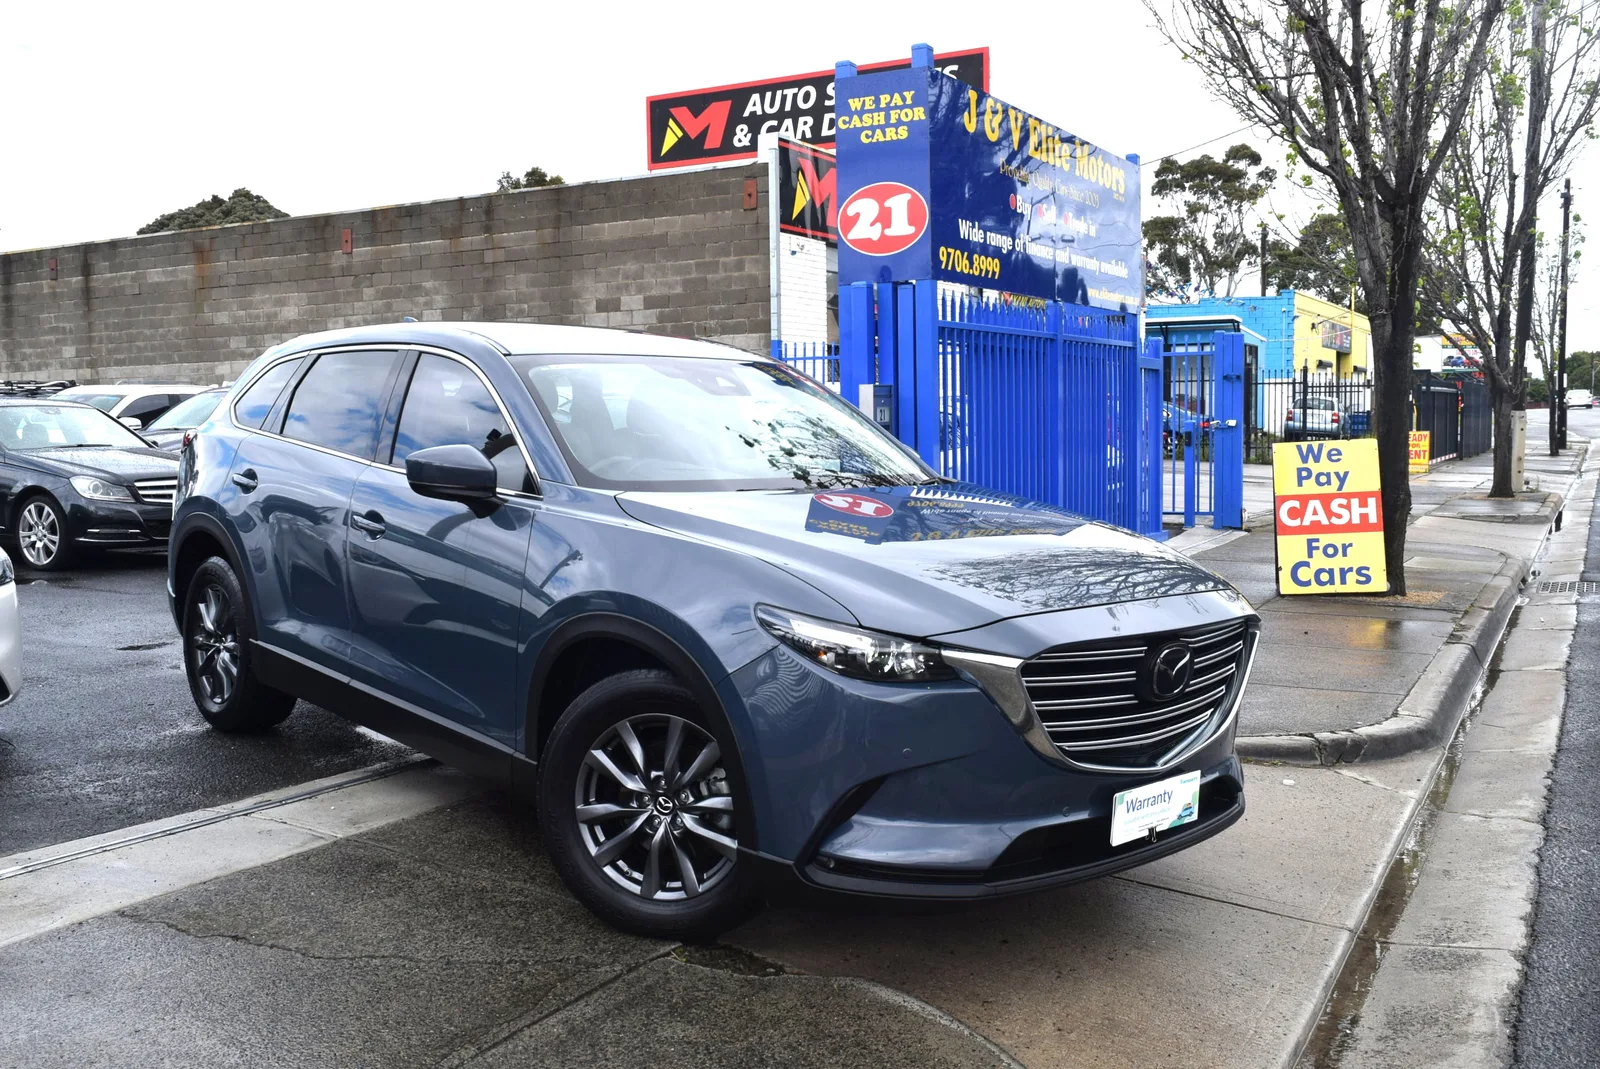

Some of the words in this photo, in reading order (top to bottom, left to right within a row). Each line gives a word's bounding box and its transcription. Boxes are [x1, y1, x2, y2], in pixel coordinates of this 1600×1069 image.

[743, 85, 817, 117] AUTO
[848, 96, 875, 111] WE
[879, 91, 915, 108] PAY
[838, 111, 885, 129] CASH
[890, 107, 926, 123] FOR
[733, 124, 752, 147] &
[860, 126, 908, 143] CARS
[964, 89, 978, 133] J
[984, 98, 1002, 142] &
[1008, 107, 1023, 151] V
[1028, 117, 1070, 172] Elite
[1075, 140, 1125, 194] Motors
[847, 193, 916, 241] 21
[1016, 195, 1032, 220] Buy
[959, 218, 984, 243] Wide
[987, 231, 1013, 254] range
[1015, 233, 1024, 252] of
[1025, 234, 1053, 260] finance
[1055, 246, 1070, 264] and
[1070, 253, 1100, 275] warranty
[1100, 259, 1128, 279] available
[939, 246, 1000, 279] 9706.8999
[879, 409, 885, 421] 21
[1409, 433, 1428, 442] EADY
[1296, 443, 1343, 464] We
[1409, 450, 1427, 460] ENT
[1296, 466, 1349, 491] Pay
[1279, 497, 1378, 527] CASH
[1306, 538, 1353, 558] For
[1290, 560, 1372, 587] Cars
[1126, 790, 1173, 813] Warranty
